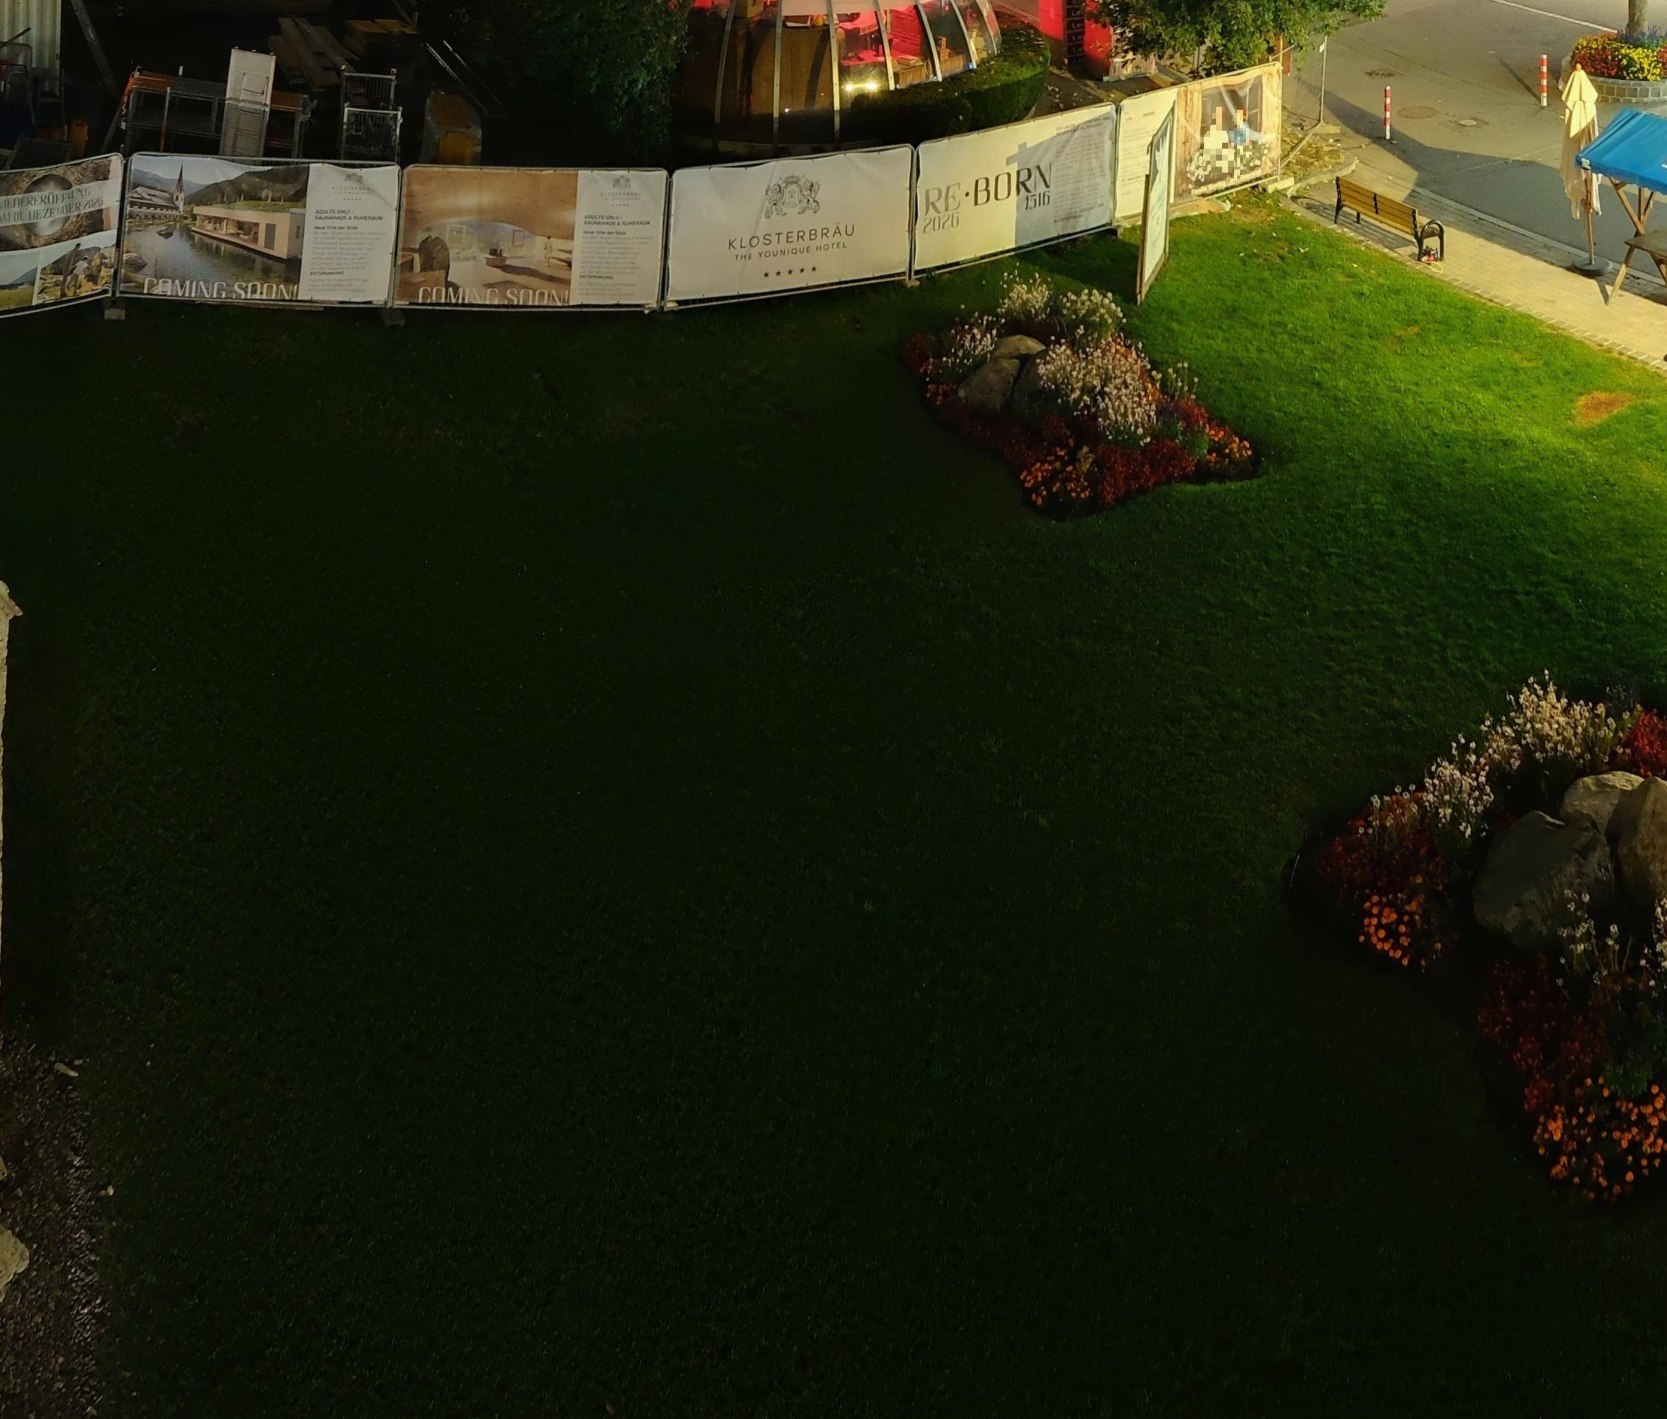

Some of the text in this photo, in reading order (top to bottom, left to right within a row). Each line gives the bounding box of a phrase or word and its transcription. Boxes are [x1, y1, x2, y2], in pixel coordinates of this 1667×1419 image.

[922, 213, 960, 235] 2026
[727, 221, 856, 251] KLOSTERBRÄU
[734, 241, 848, 261] THE YOUNIQUE HOTEL
